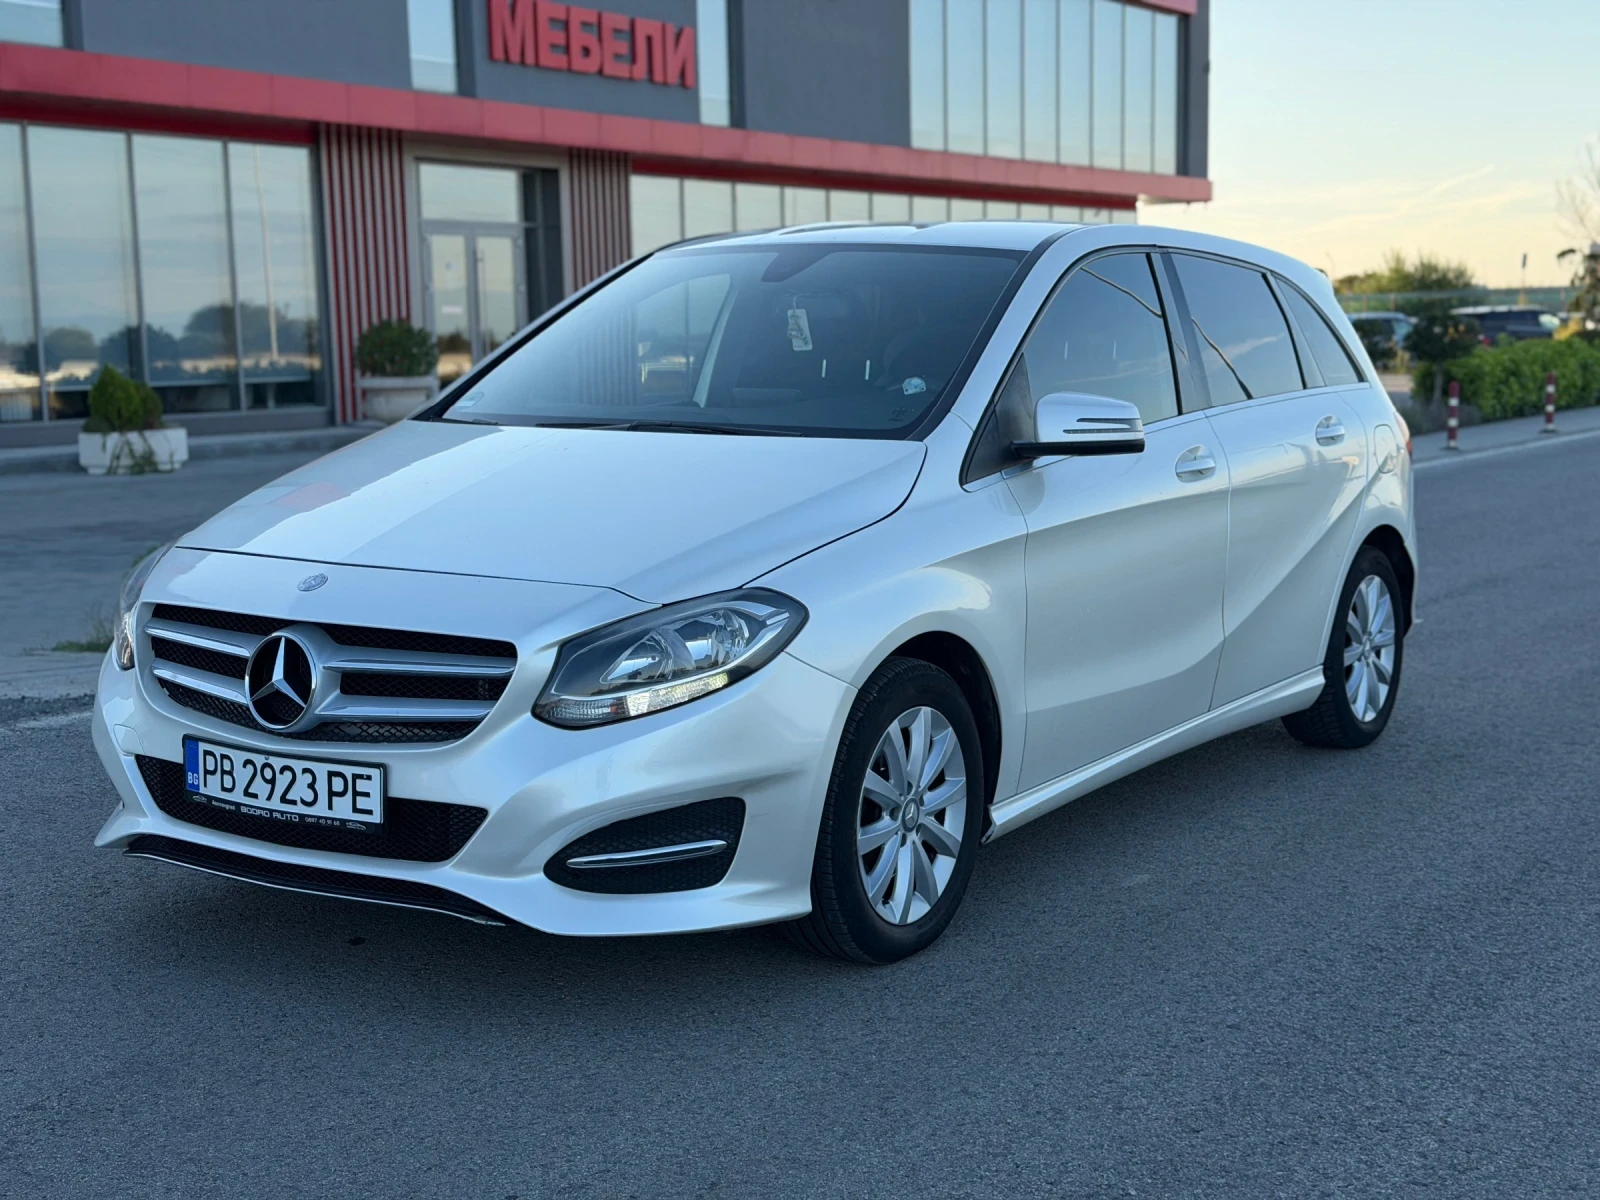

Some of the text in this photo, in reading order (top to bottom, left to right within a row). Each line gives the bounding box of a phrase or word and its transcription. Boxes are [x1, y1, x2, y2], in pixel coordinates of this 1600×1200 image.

[488, 0, 696, 88] МЕБЕЛИ
[188, 772, 199, 785] BG
[203, 749, 374, 815] PB 2923 PE
[273, 812, 299, 822] AUTO
